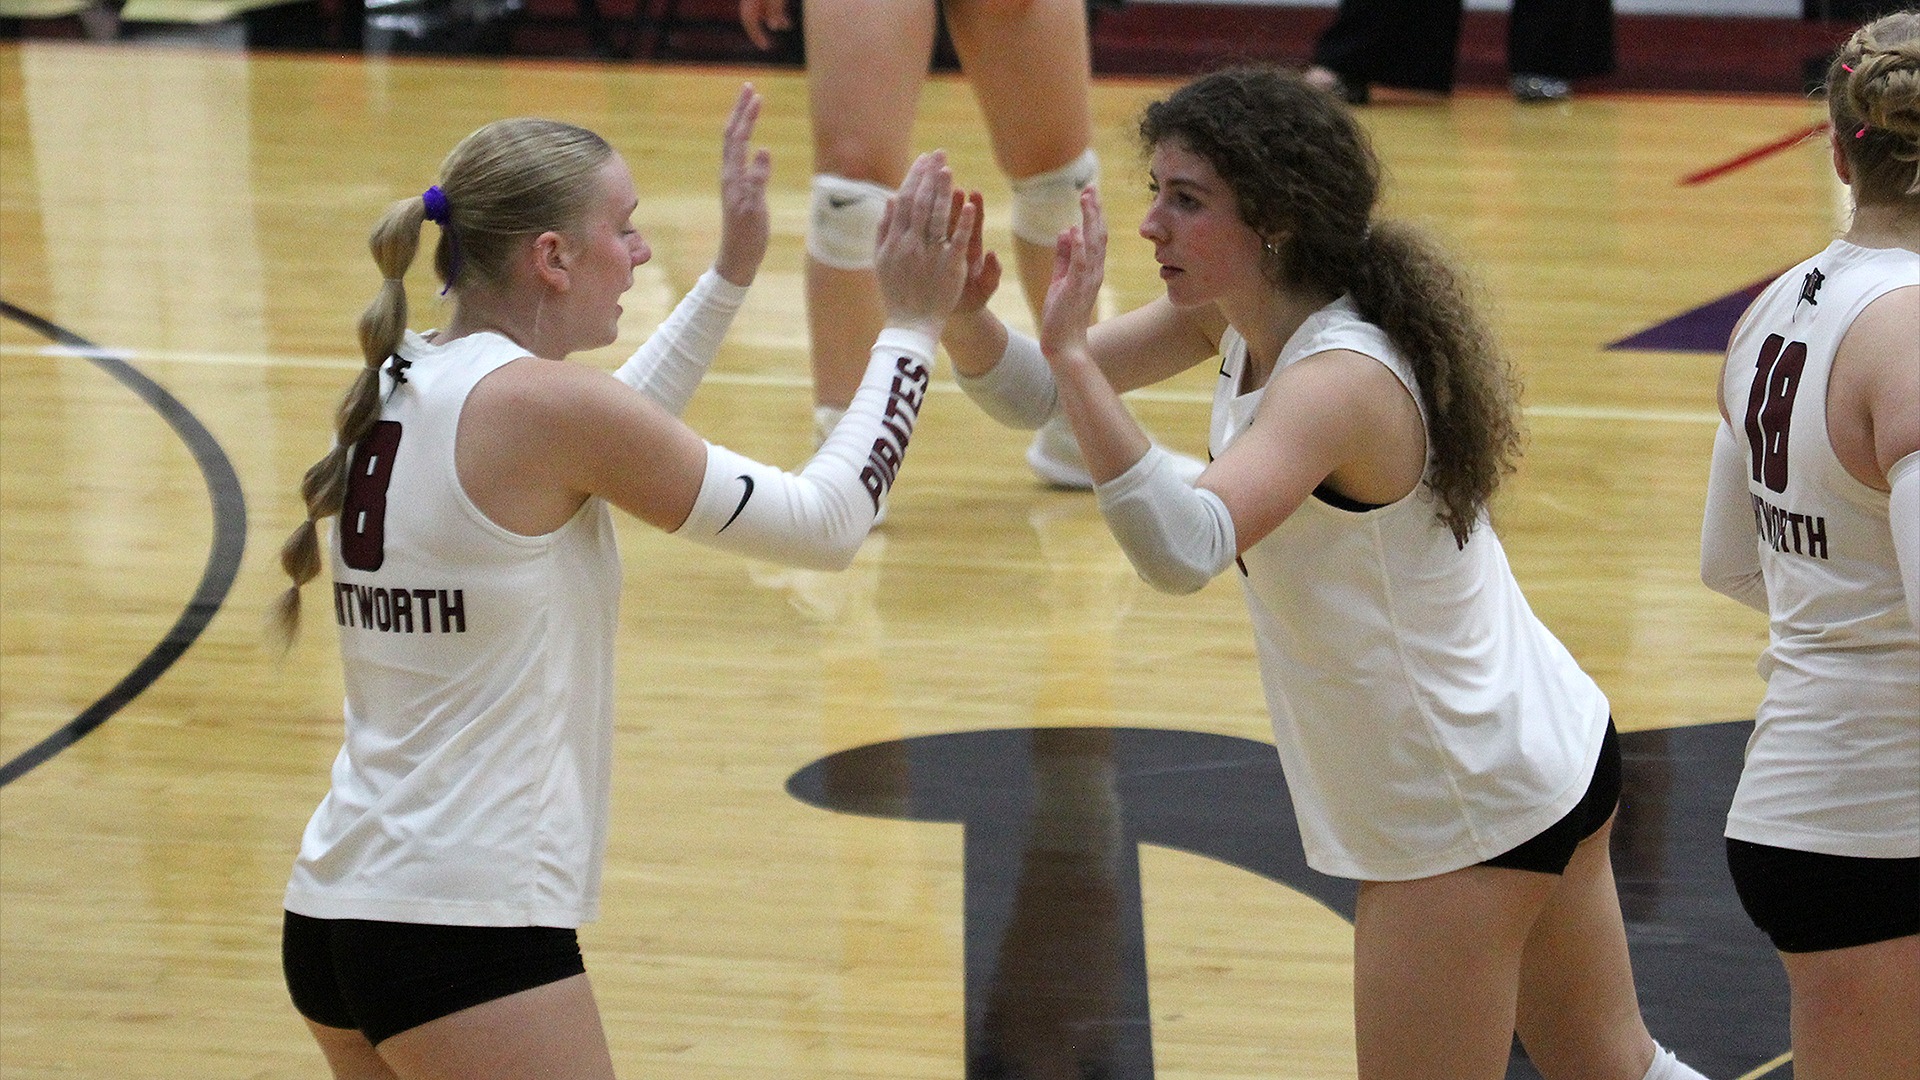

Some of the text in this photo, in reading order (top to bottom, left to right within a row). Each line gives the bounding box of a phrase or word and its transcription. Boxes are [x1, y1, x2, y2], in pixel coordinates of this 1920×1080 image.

[859, 356, 930, 518] PIRATES
[1745, 333, 1808, 494] 18
[341, 420, 403, 572] 8
[333, 582, 467, 633] ITWORTH
